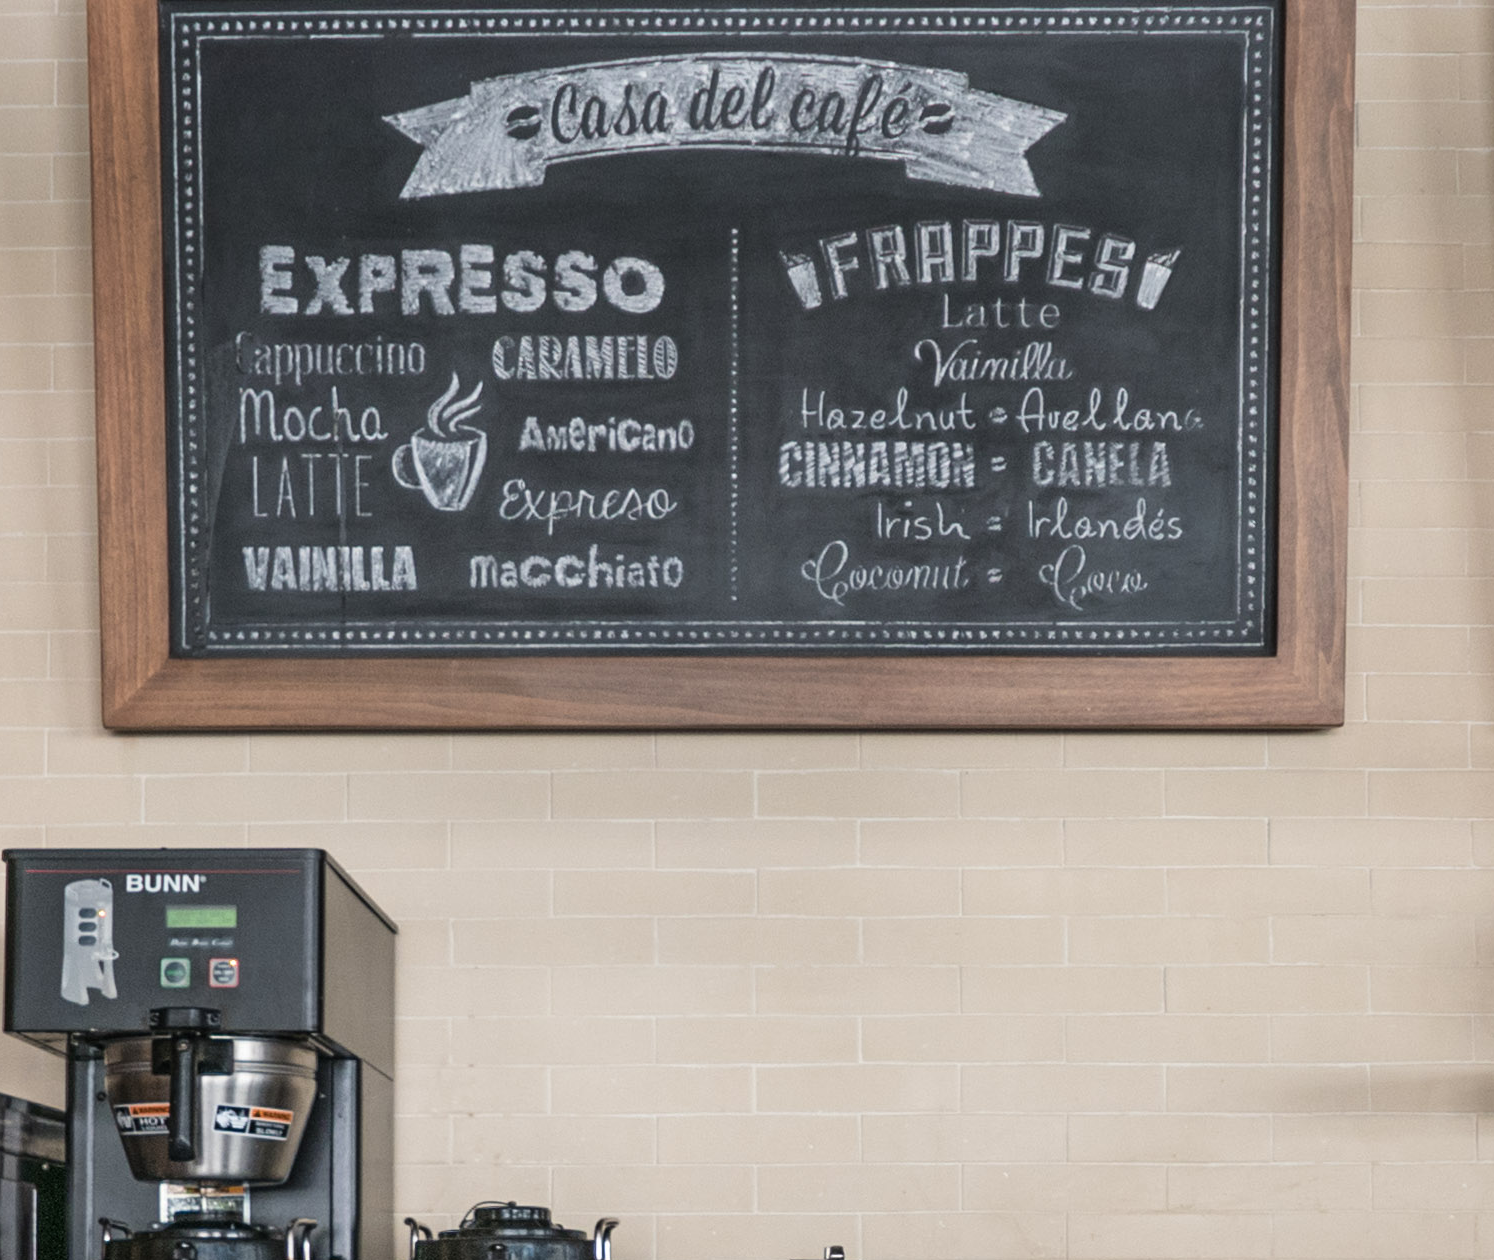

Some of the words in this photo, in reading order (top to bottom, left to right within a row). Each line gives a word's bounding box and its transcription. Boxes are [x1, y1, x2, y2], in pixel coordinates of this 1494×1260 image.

[550, 80, 674, 146] Casa
[688, 66, 775, 131] del
[789, 72, 913, 157] café
[258, 243, 665, 316] EXPRESSO
[818, 217, 1136, 300] FRAPPES
[941, 293, 1060, 330] Latte
[235, 332, 426, 385] Cappuccino
[491, 334, 679, 381] CARAMELO
[914, 338, 1074, 388] Vainilla
[238, 385, 389, 446] Mocha
[518, 416, 696, 453] Americano
[801, 387, 977, 432] Hazelnut
[1015, 387, 1204, 433] Avellana
[253, 453, 374, 520] LATTE
[779, 440, 977, 488] CINNAMON
[1031, 440, 1172, 488] CANELA
[499, 478, 678, 536] Expreso
[876, 500, 971, 541] Irish
[1028, 496, 1183, 542] Irlandés
[242, 545, 418, 592] VAINILLA
[801, 540, 969, 607] Coconut
[1039, 544, 1148, 612] Coco
[126, 875, 200, 892] BUNN
[140, 1117, 166, 1126] HOT
